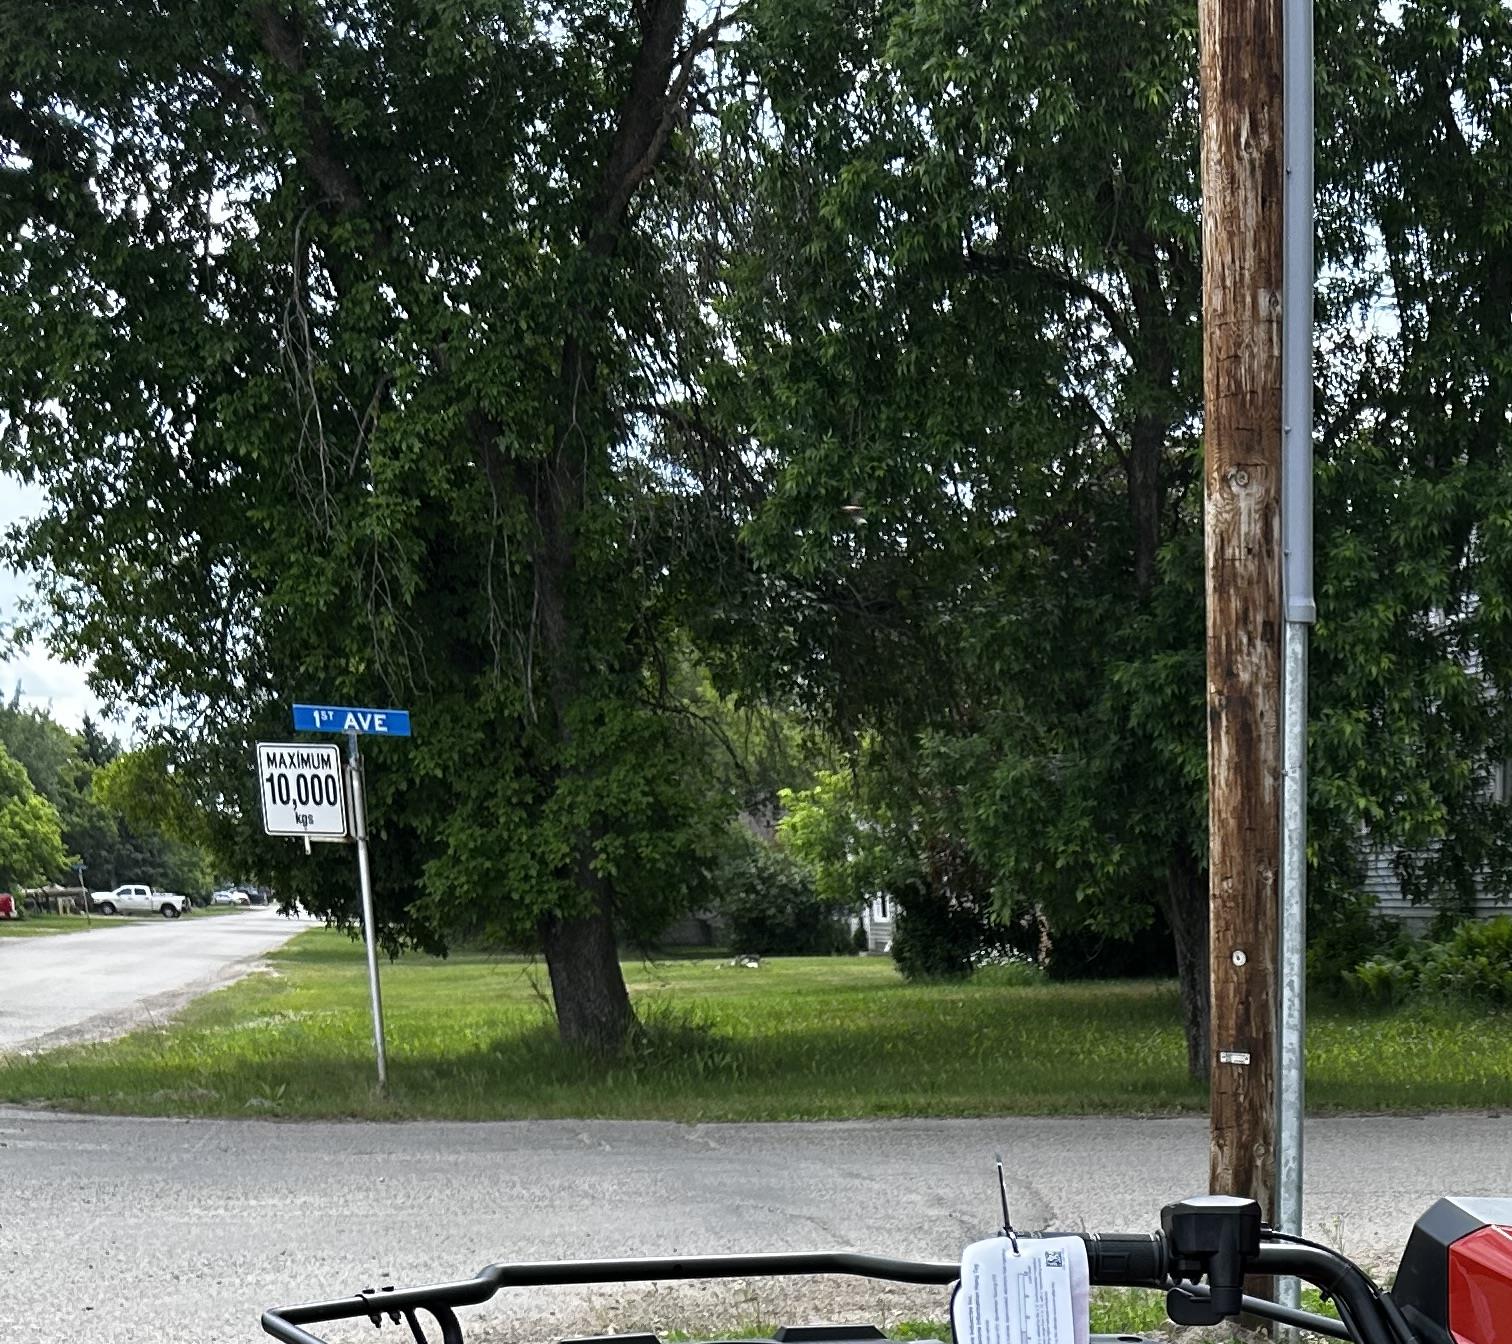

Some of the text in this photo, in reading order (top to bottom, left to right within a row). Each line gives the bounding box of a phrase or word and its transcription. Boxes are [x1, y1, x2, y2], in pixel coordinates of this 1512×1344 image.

[313, 709, 388, 733] 1ST AVE
[266, 751, 332, 771] MAXIMUM
[266, 773, 338, 811] 10,000
[295, 813, 315, 827] kgs
